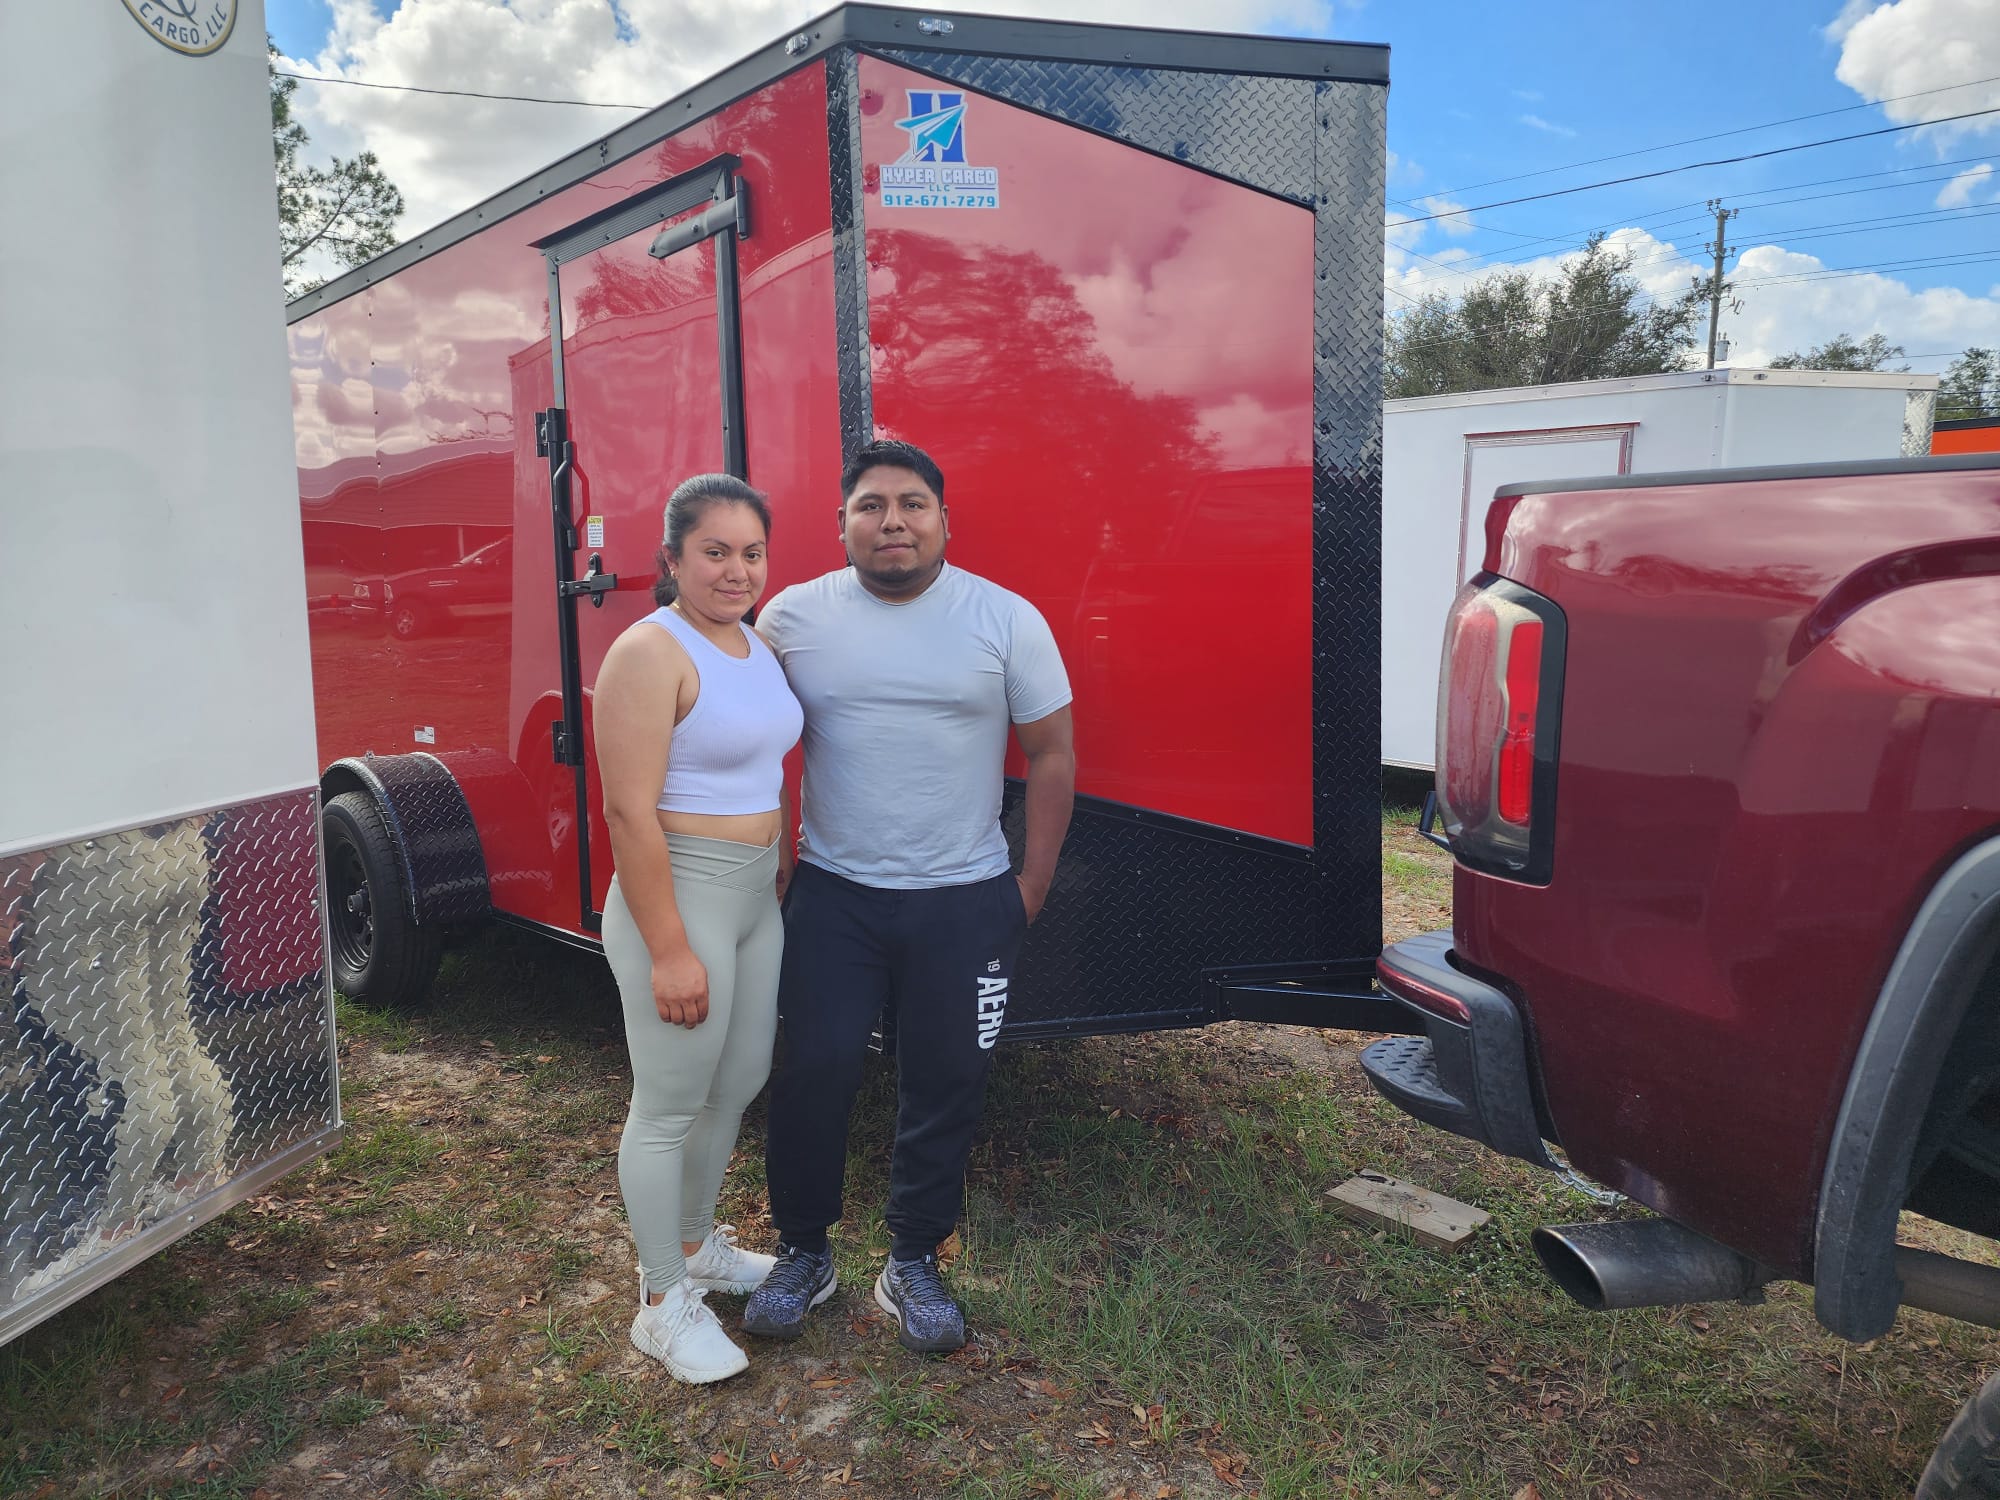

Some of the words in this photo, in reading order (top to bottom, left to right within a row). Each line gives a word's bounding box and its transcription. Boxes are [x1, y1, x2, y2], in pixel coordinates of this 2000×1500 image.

[205, 3, 228, 38] LLC
[882, 166, 936, 184] HYPER
[941, 168, 996, 185] CARGO
[929, 184, 951, 192] LLC
[884, 194, 996, 207] 912-671-7279
[987, 958, 1001, 973] 19
